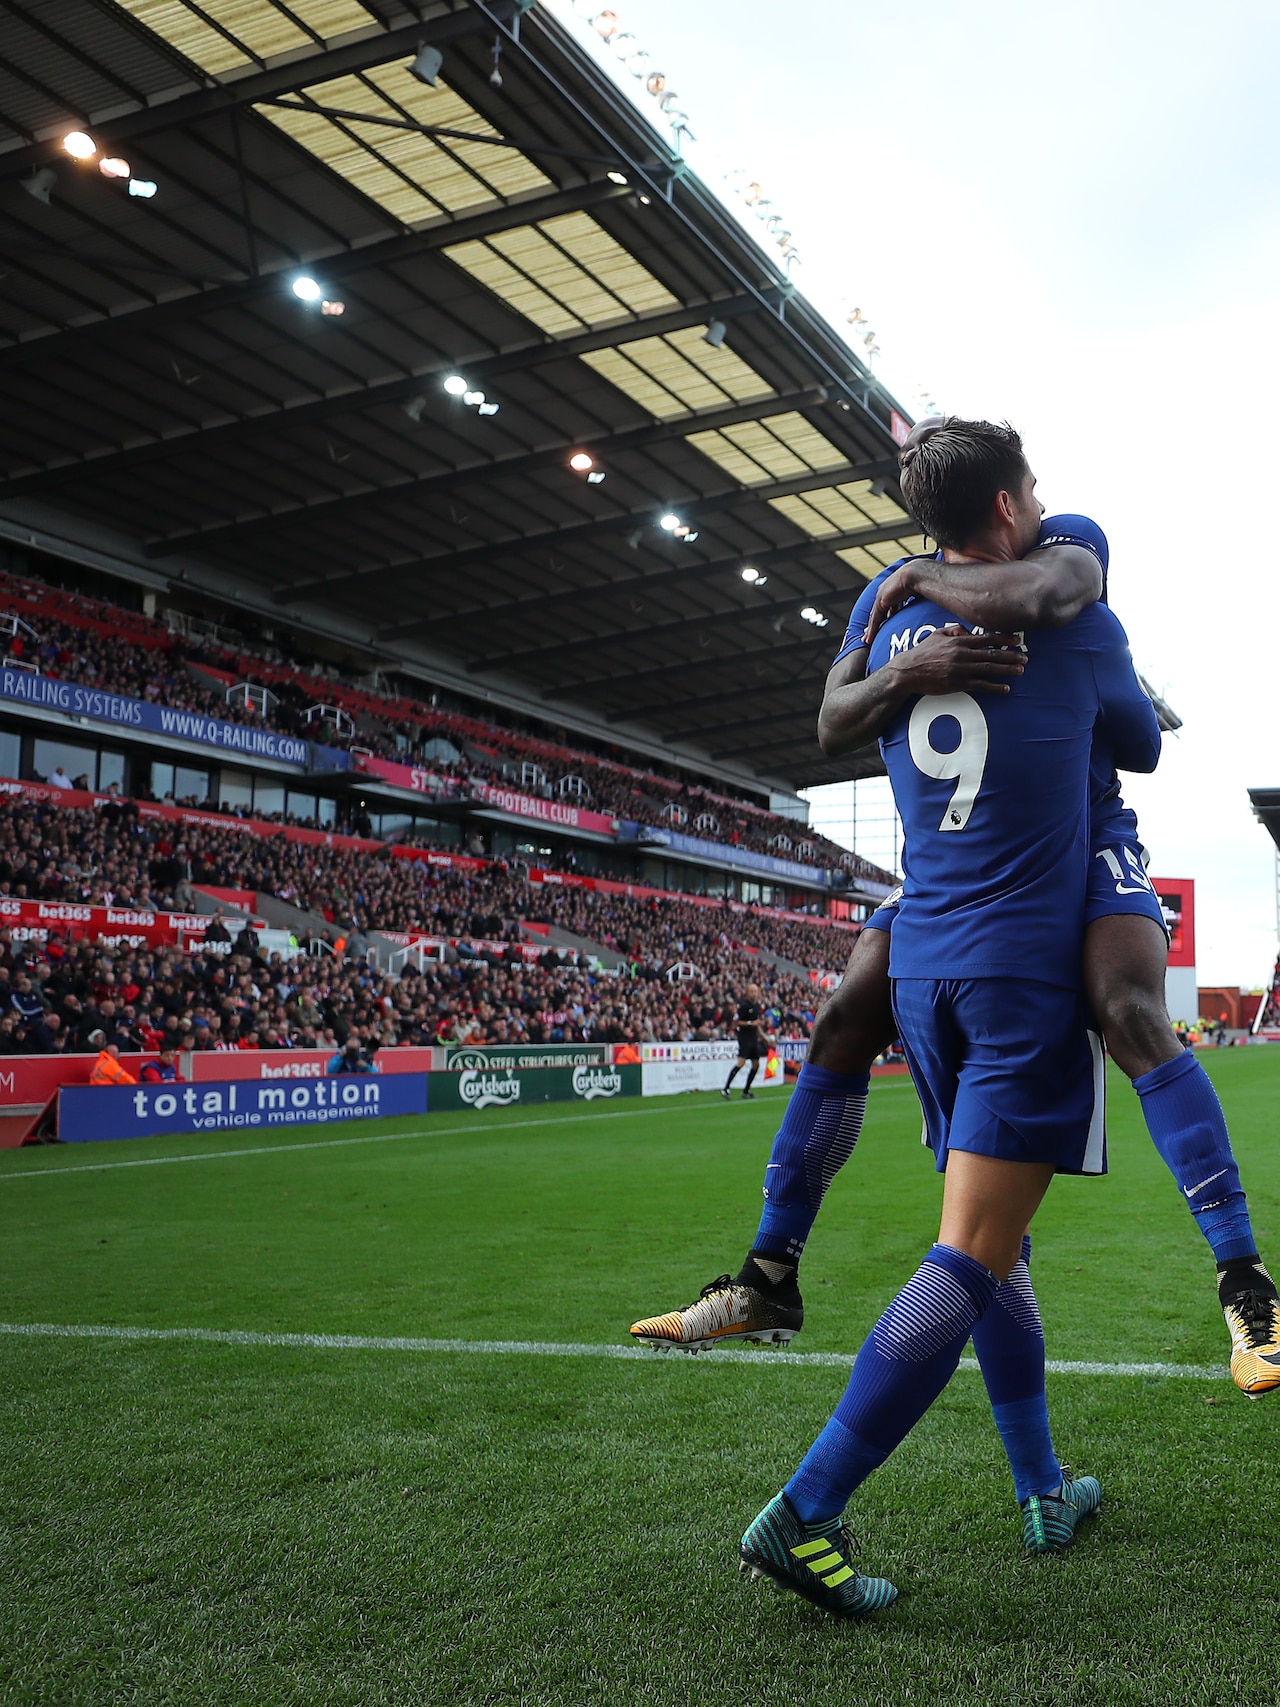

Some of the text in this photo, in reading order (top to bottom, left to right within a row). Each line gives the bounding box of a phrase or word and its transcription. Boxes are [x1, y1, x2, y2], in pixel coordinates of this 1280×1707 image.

[3, 671, 142, 724] RAILING SYSTEMS
[160, 709, 306, 763] WWW.Q-RAILING.COM
[908, 690, 990, 831] 9
[488, 788, 549, 821] FOOTBALL
[550, 804, 578, 826] CLUB
[38, 903, 92, 921] bet365
[106, 910, 155, 927] bet365
[260, 1063, 321, 1079] bet365
[459, 1070, 521, 1110] Carlsberg
[572, 1065, 621, 1101] Carlsberg
[133, 1080, 380, 1118] total motion
[193, 1104, 380, 1128] vehicle management
